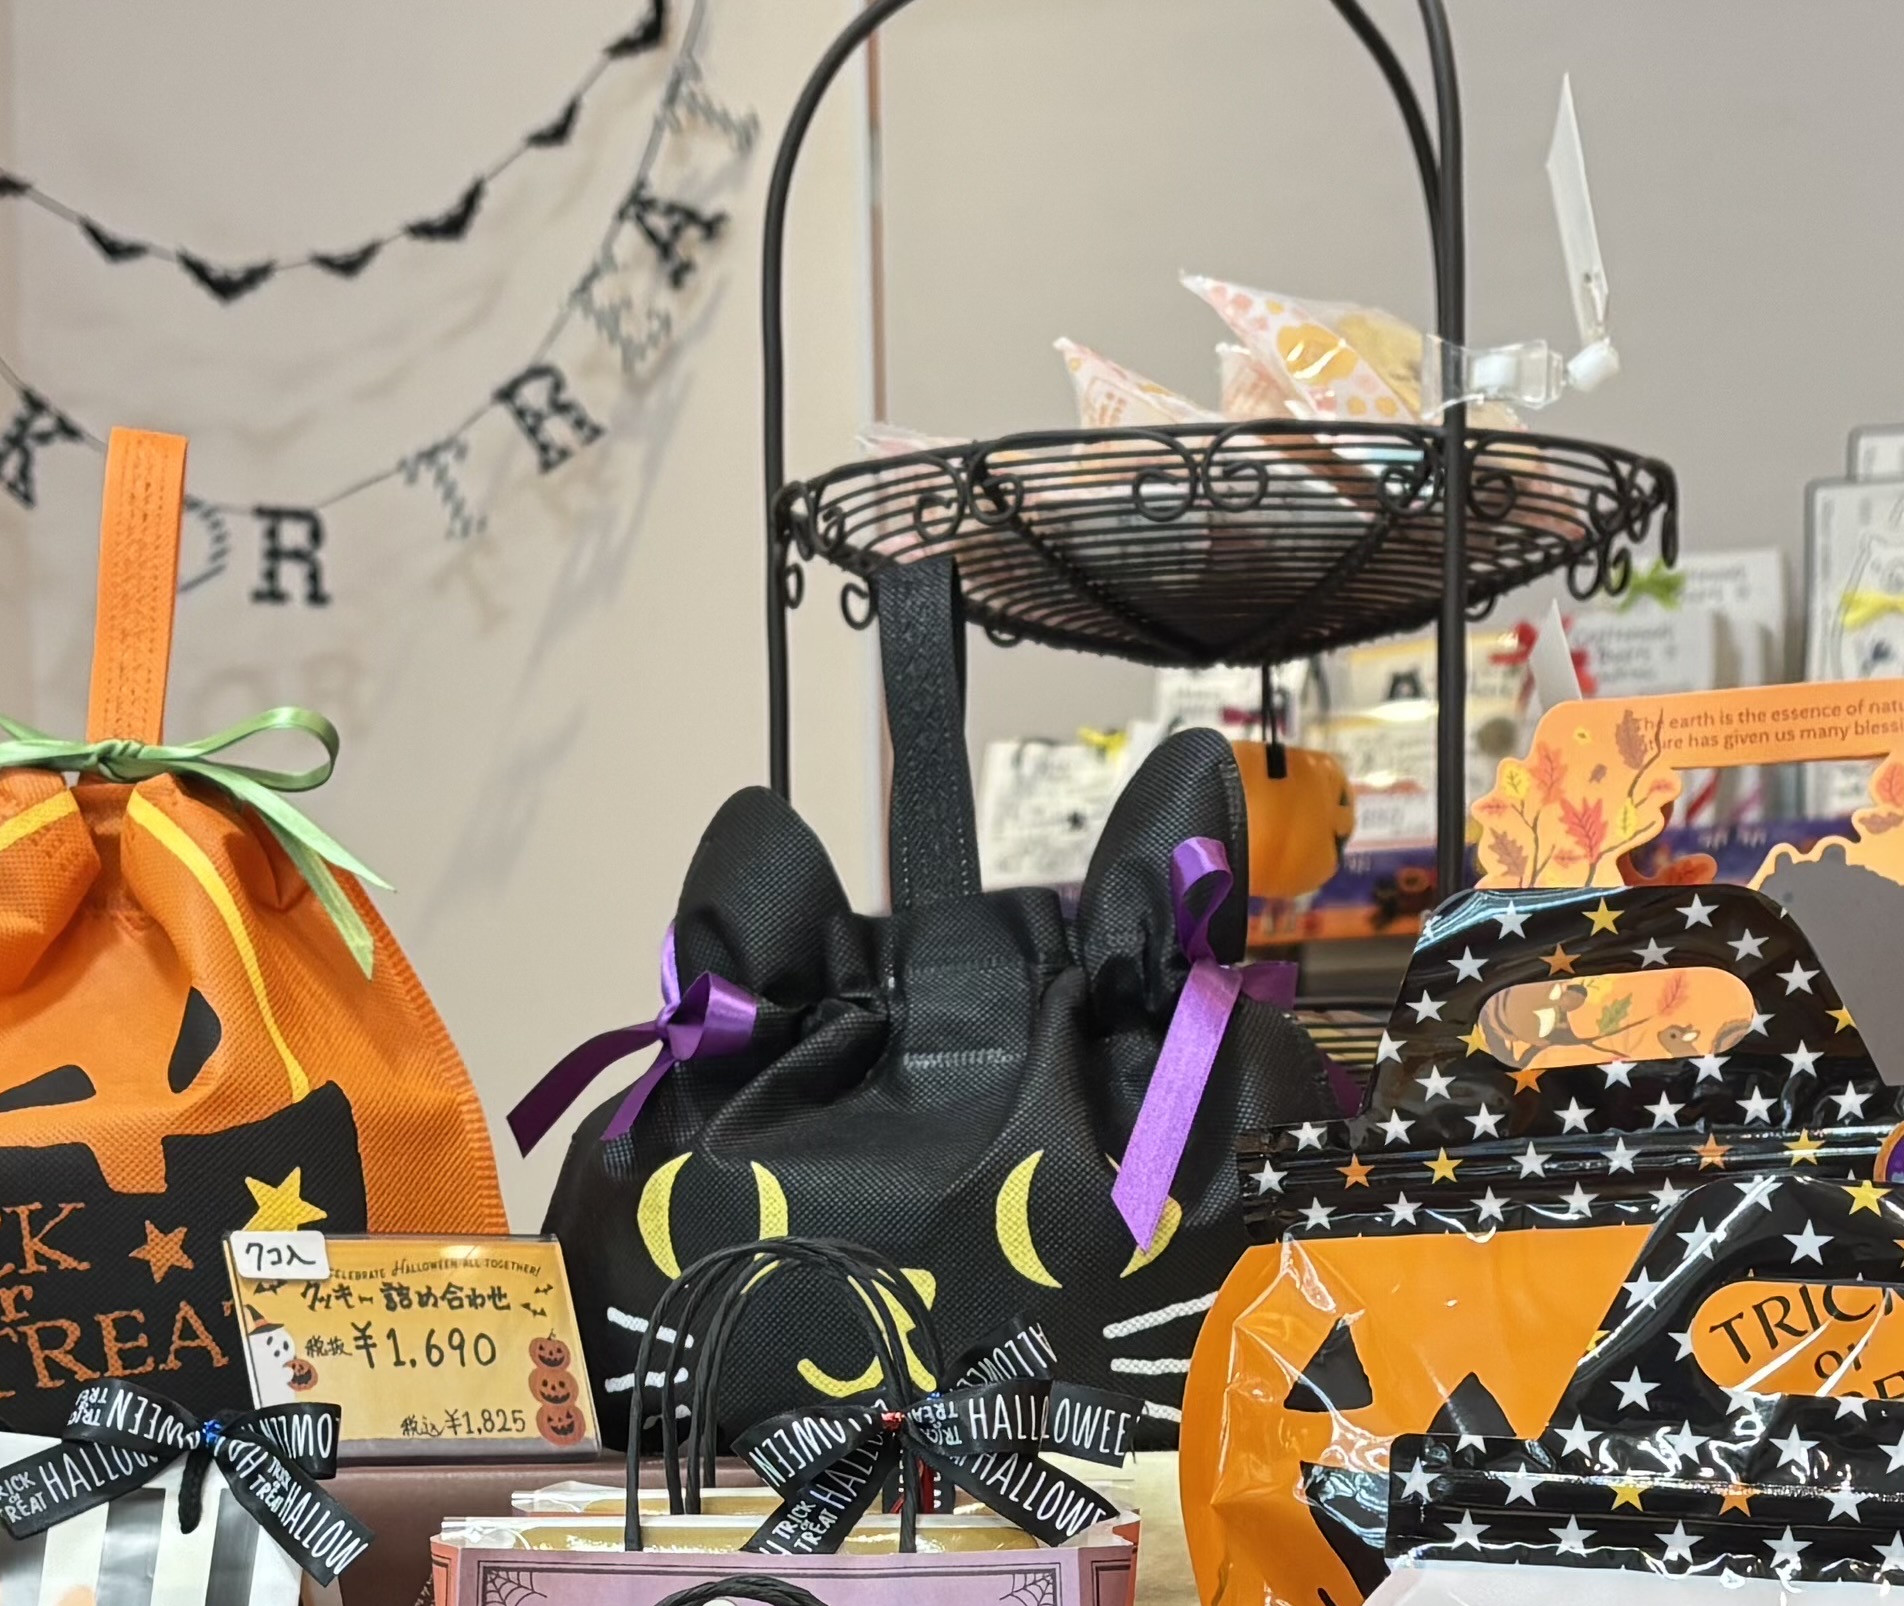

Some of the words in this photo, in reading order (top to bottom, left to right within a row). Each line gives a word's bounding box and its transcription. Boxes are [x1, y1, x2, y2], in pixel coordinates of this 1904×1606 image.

[245, 1242, 316, 1271] 7コ入
[391, 1255, 458, 1277] HALLOWEEN
[462, 1259, 481, 1269] ALL
[484, 1258, 541, 1277] TOGETHER!
[444, 1409, 527, 1437] ¥1,825
